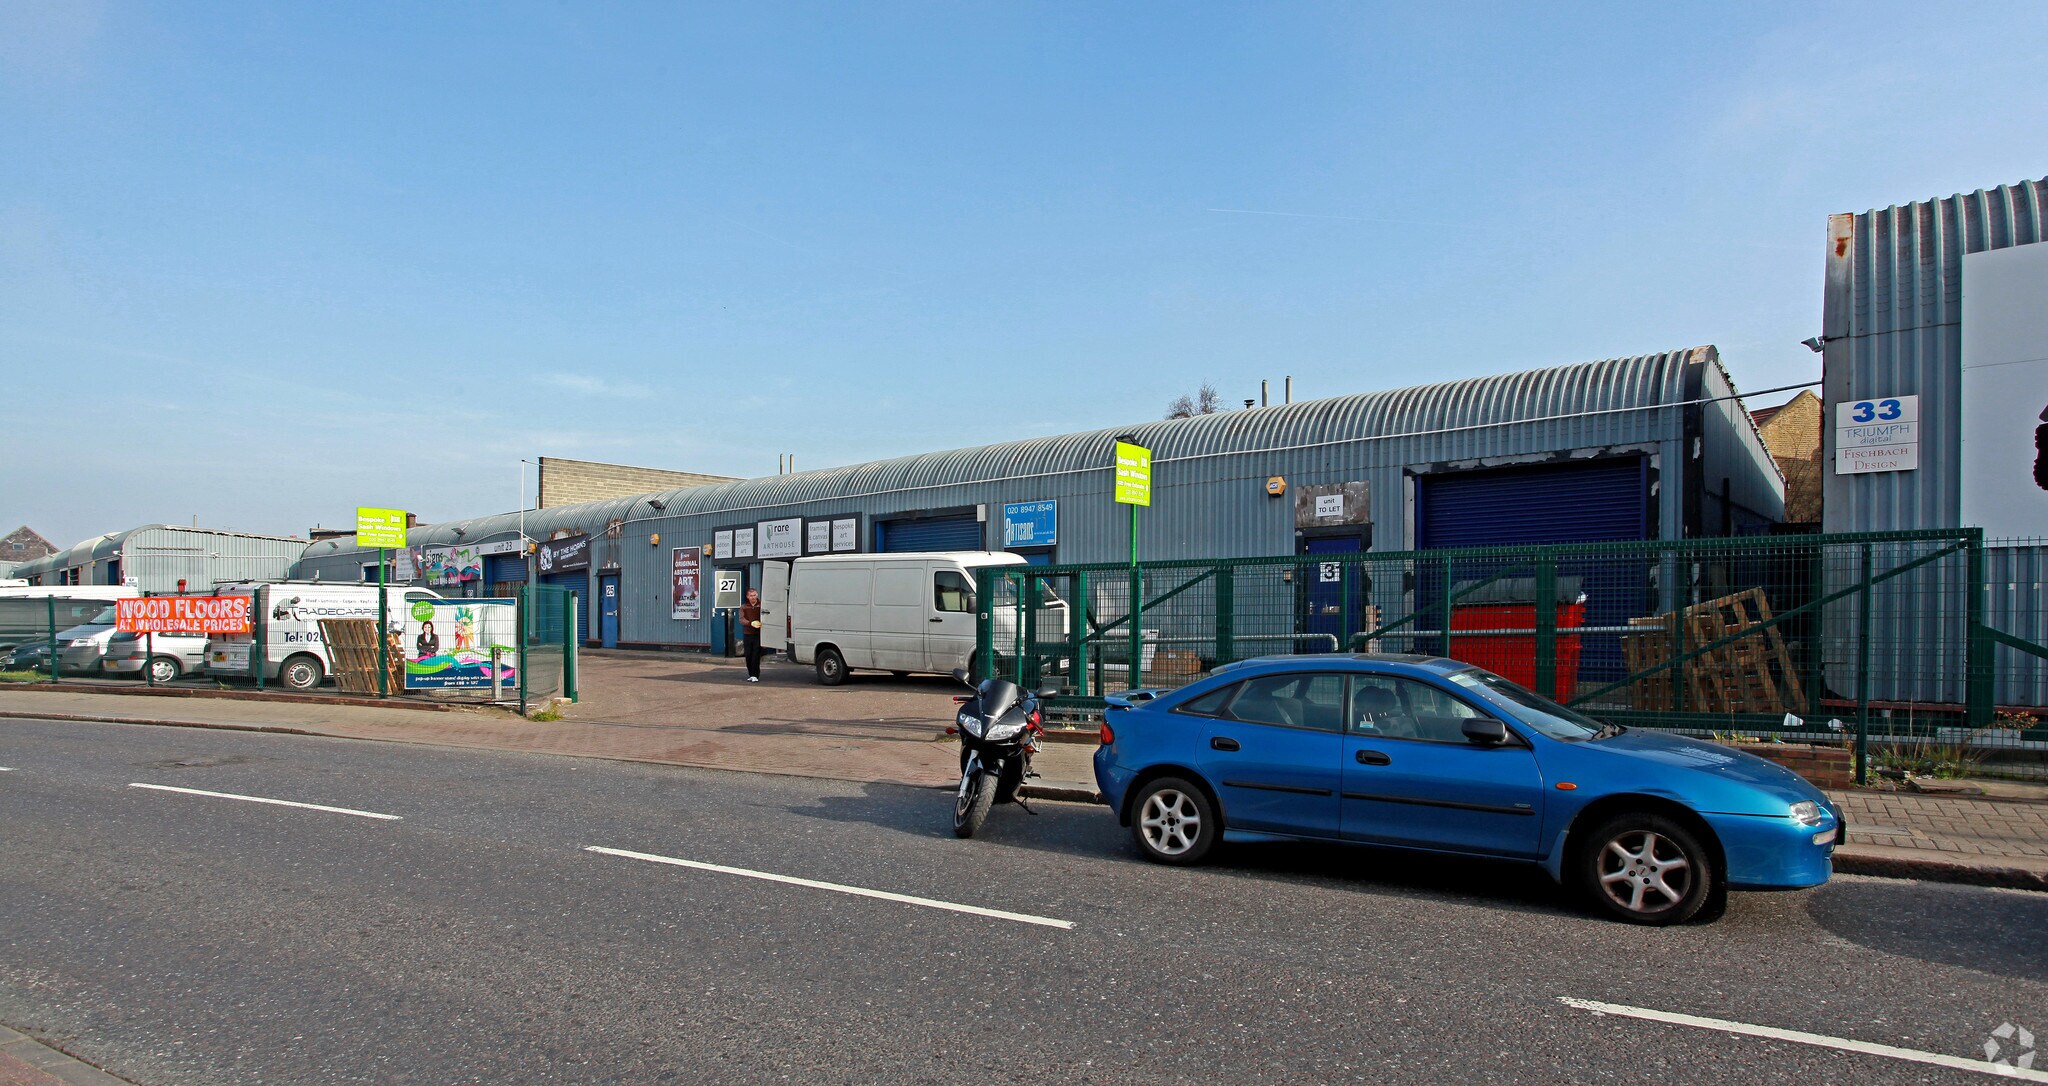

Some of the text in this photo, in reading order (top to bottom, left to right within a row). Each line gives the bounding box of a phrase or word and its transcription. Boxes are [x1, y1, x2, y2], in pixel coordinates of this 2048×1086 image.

[1852, 399, 1902, 423] 33
[1845, 424, 1910, 438] TRIUMPH
[1860, 435, 1892, 445] digital
[1844, 448, 1908, 459] FISCHBACH
[1854, 460, 1898, 470] DESIGN
[1007, 503, 1053, 514] 020 8947 8549
[358, 515, 386, 524] Bespoke
[774, 524, 790, 533] rare
[833, 522, 855, 530] bespoke
[494, 541, 513, 552] unit 23
[560, 546, 570, 555] THE
[570, 540, 587, 552] HORNS
[763, 541, 795, 550] ARTHOUSE
[809, 542, 827, 550] printing
[426, 550, 443, 565] signs
[674, 560, 698, 568] ORIGINAL
[674, 568, 699, 576] ABSTRACT
[1324, 563, 1340, 580] 3
[678, 576, 693, 586] ART
[720, 580, 736, 591] 27
[606, 586, 614, 595] 25
[119, 599, 170, 619] WOOD
[175, 598, 245, 619] FLOORS
[288, 606, 379, 617] TRADECARPE
[119, 618, 243, 631] AT WHOLESALE PRICES
[285, 632, 324, 643] Tel: 02
